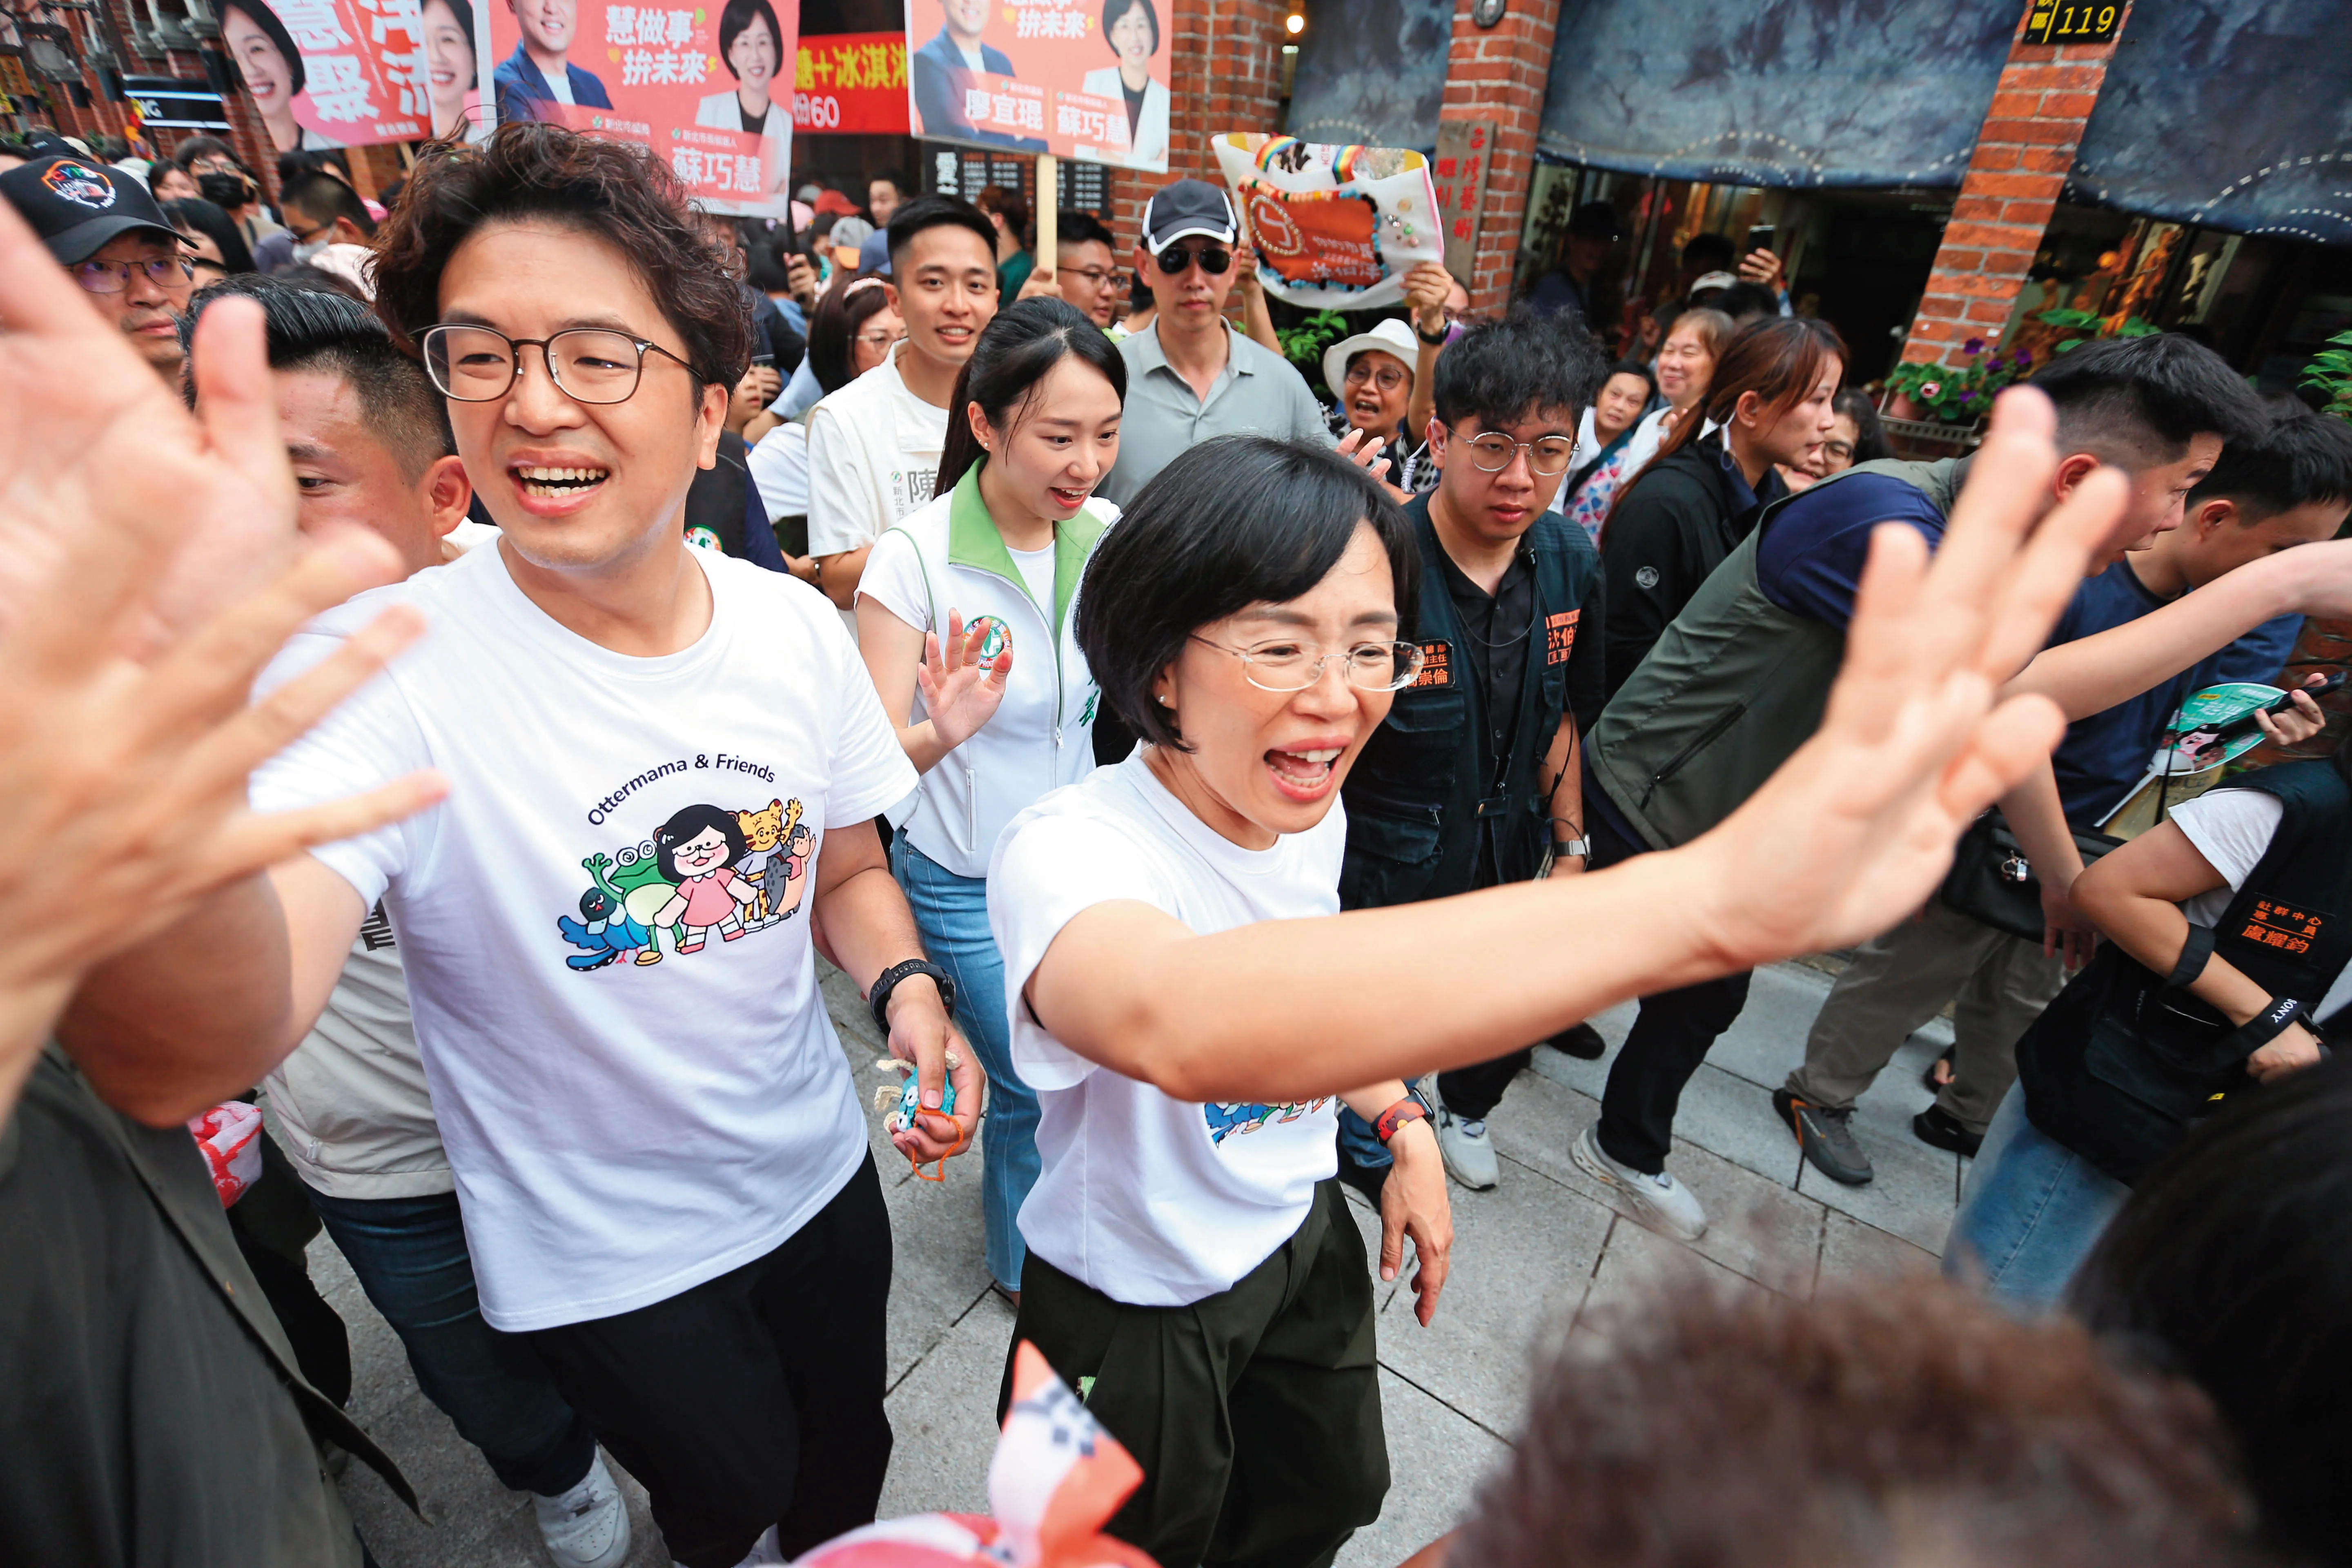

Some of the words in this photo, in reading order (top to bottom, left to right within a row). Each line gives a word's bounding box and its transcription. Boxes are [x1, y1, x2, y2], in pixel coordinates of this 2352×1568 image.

[606, 5, 694, 49] 慧做事
[2056, 6, 2115, 34] 119
[1057, 105, 1128, 144] 蘇巧慧
[672, 146, 761, 192] 蘇巧慧
[907, 468, 938, 503] 陳
[1548, 626, 1577, 650] 沈伯
[588, 757, 688, 825] Ottermama
[694, 754, 709, 768] &
[716, 753, 775, 783] Friends
[2257, 900, 2322, 926] 社群中心
[2270, 998, 2297, 1023] SONY
